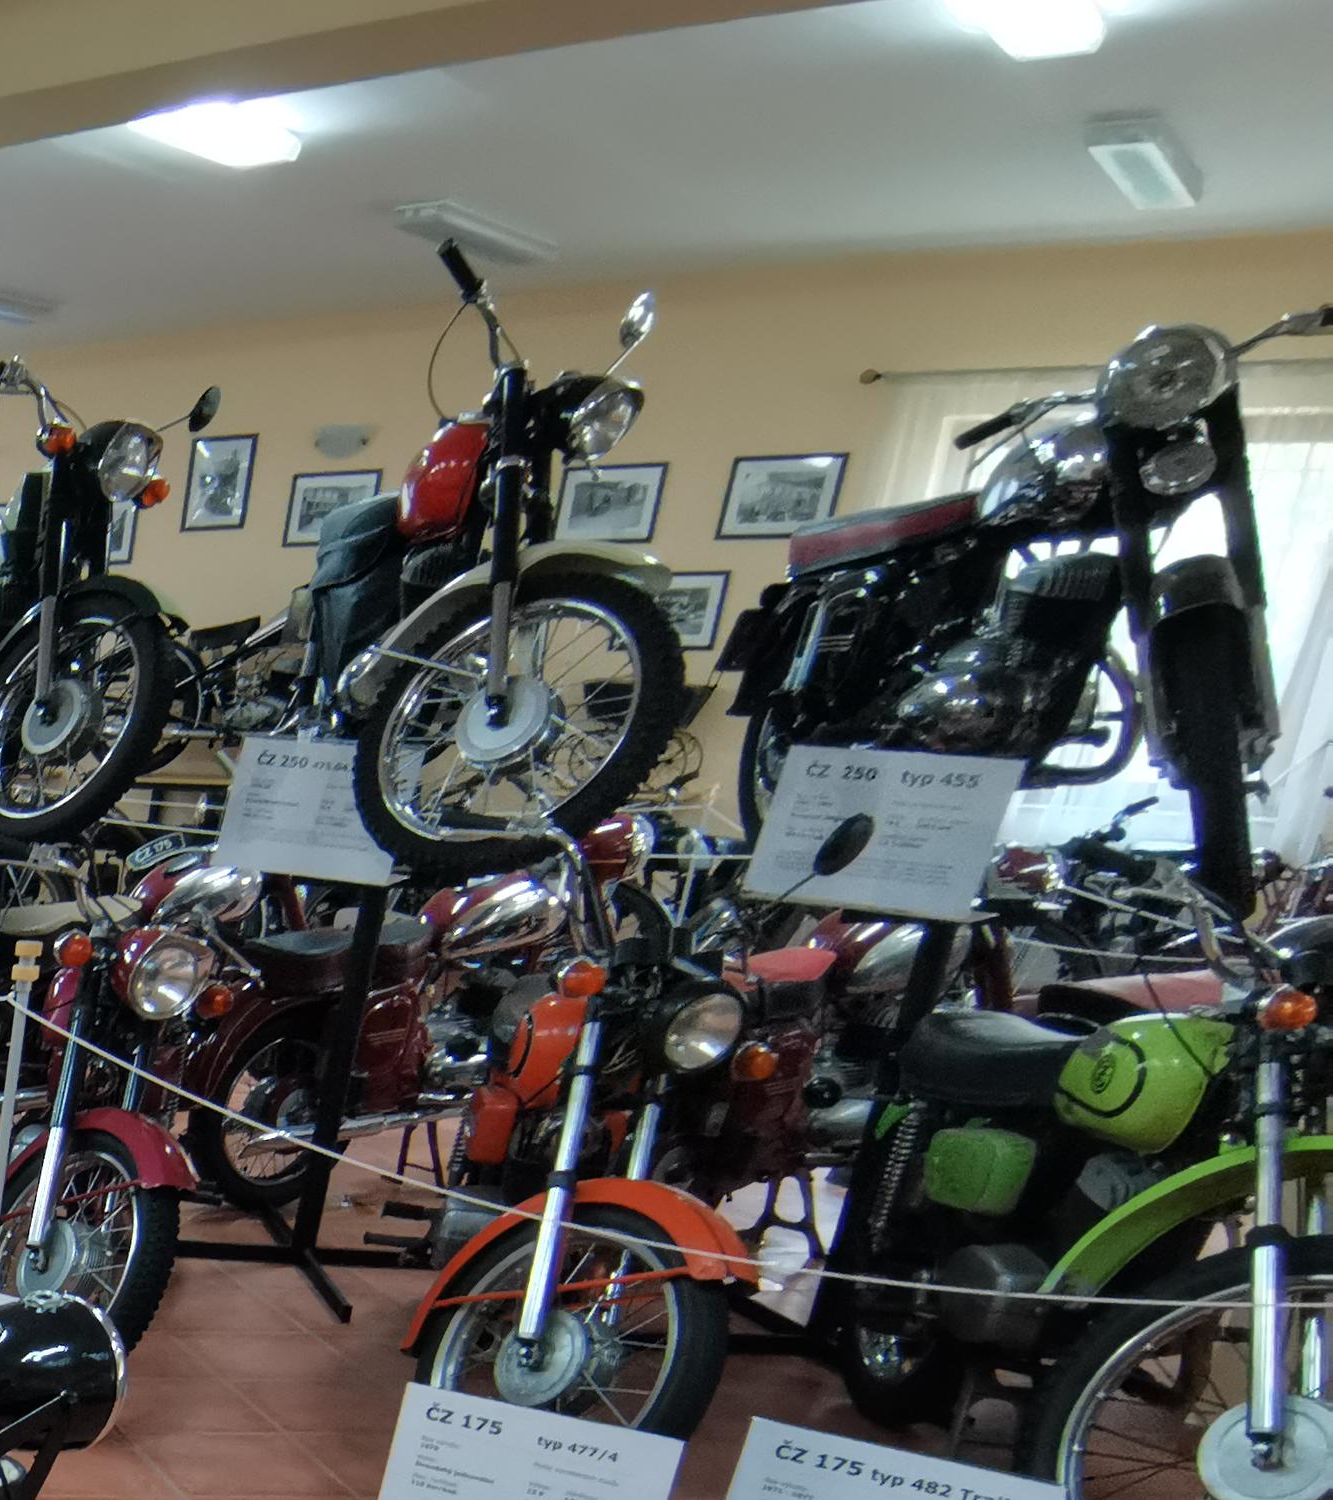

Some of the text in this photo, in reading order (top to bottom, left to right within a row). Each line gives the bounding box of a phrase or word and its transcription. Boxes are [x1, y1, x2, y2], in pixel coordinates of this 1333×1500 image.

[257, 749, 276, 766] ČZ
[279, 754, 309, 769] 250
[806, 761, 981, 788] ČZ 250 typ 455
[424, 1401, 620, 1463] ČZ 175 typ 477/4
[774, 1439, 810, 1464] ČZ
[814, 1452, 866, 1477] 175
[870, 1466, 905, 1488] typ
[911, 1477, 952, 1499] 482
